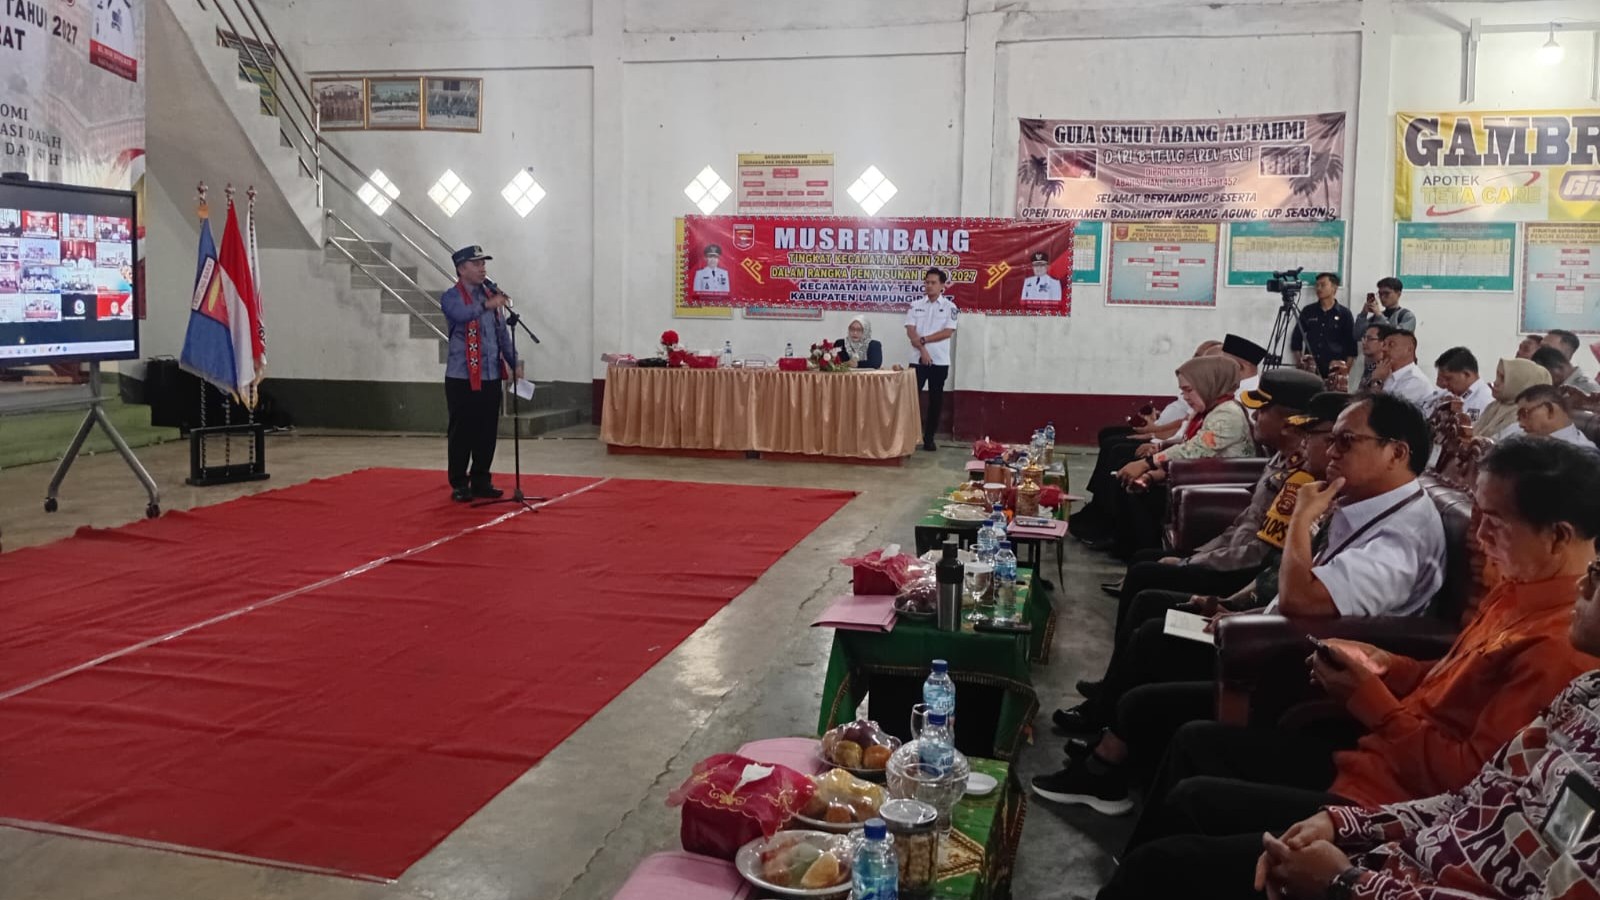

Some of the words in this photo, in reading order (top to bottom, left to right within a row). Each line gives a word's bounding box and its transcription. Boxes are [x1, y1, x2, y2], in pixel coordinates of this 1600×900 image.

[52, 15, 78, 45] 2027
[1054, 125, 1096, 144] GULA
[1101, 125, 1154, 144] SEMUT
[1159, 125, 1218, 143] ABANG
[1422, 175, 1480, 186] APOTEK
[1096, 193, 1143, 203] SELAMAT
[1143, 193, 1209, 203] BERTANDING
[1212, 192, 1257, 203] PESERTA
[1421, 186, 1477, 204] TETA
[1481, 186, 1541, 204] CARE
[1022, 208, 1049, 218] OPEN
[1051, 208, 1107, 219] TURNAMEN
[1110, 209, 1173, 219] BADMINTON
[1175, 208, 1218, 219] KARANG
[1221, 208, 1258, 218] AGUNG
[1261, 208, 1283, 218] CUP
[1285, 207, 1325, 218] SEASON
[1326, 208, 1336, 219] 2
[774, 227, 970, 252] MUSRENBANG
[788, 252, 831, 264] TINGKAT
[833, 253, 895, 266] KECAMATAN
[897, 254, 932, 266] TAHUN
[771, 266, 806, 279] DALAM
[807, 267, 849, 279] RANGKA
[850, 267, 919, 281] PENYUSUNAN
[951, 270, 977, 282] 2027
[799, 283, 867, 292] KECAMATAN
[870, 284, 894, 292] WAY
[790, 292, 858, 301] KABUPATEN
[859, 294, 913, 302] LAMPUNG
